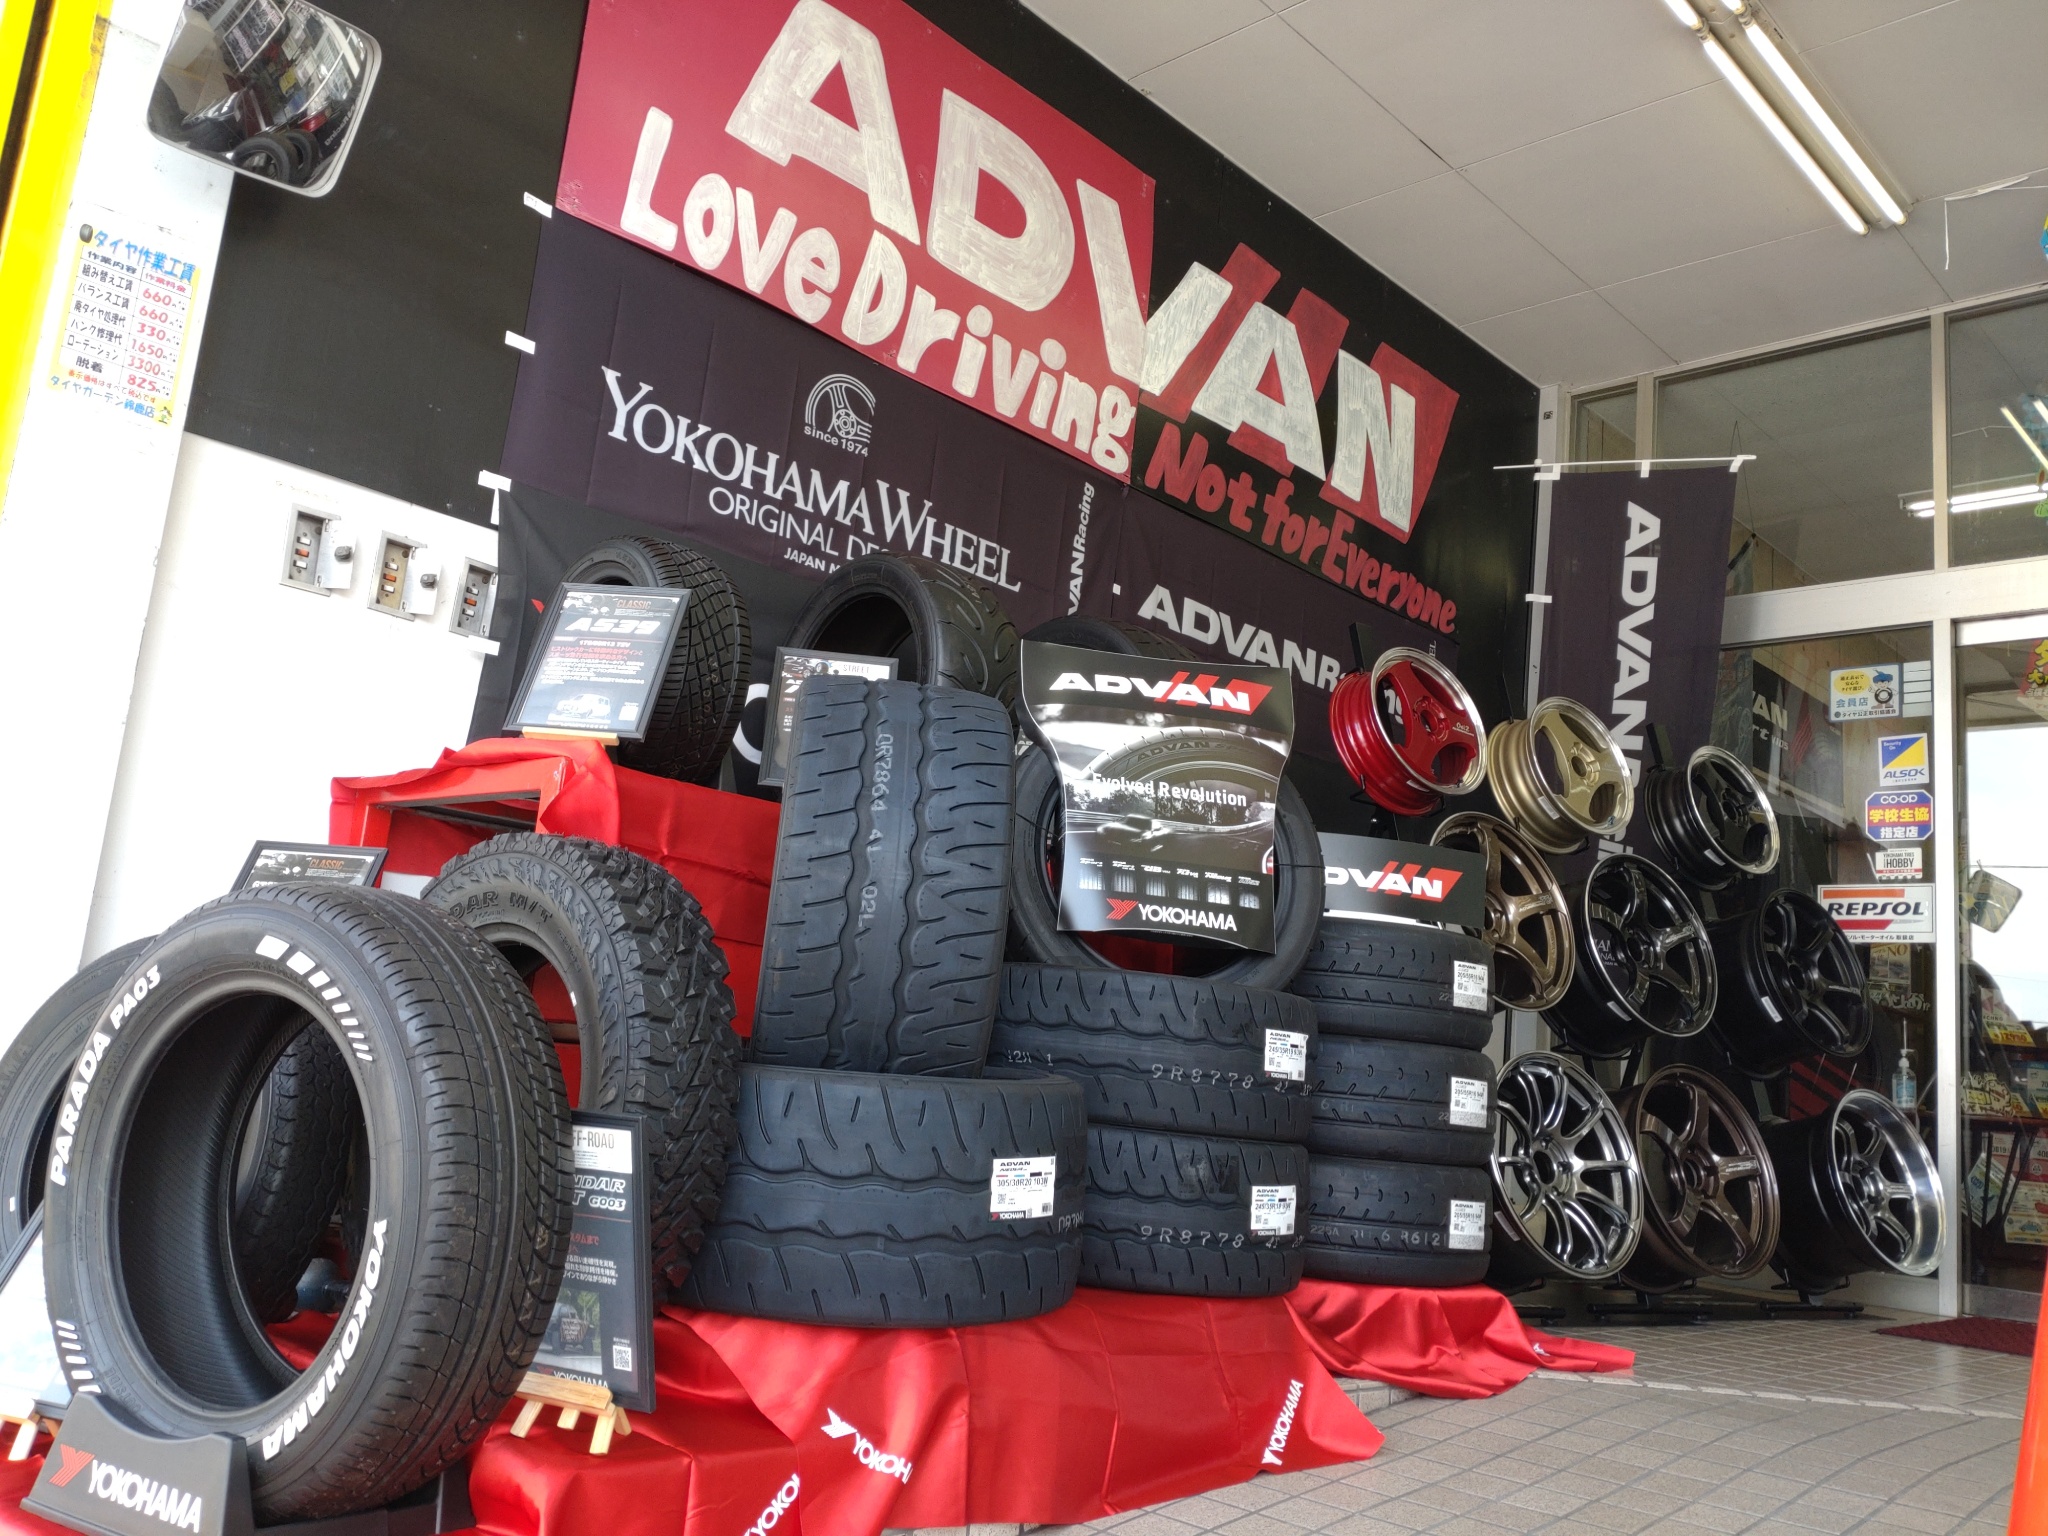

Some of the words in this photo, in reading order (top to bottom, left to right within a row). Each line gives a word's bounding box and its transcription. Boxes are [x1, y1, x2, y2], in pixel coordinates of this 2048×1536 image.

[94, 230, 196, 282] タイヤ作業工賃
[725, 0, 1415, 533] ADVAN
[803, 424, 839, 447] since
[840, 438, 869, 458] 1974
[708, 486, 839, 556] ORIGINAL
[1144, 422, 1259, 533] Not
[1321, 511, 1457, 634] Everyone
[784, 547, 826, 572] JAPAN
[617, 599, 651, 609] CLASSIC
[1049, 672, 1251, 711] ADVAN
[1836, 697, 1869, 708] 会員店
[1883, 767, 1925, 779] ALSOK
[1092, 772, 1155, 797] Evolved
[1159, 780, 1247, 807] Revolution
[1869, 806, 1929, 823] 学校生協
[1880, 826, 1919, 839] 指定店
[309, 859, 345, 870] CLASSIC
[1886, 858, 1915, 868] HOBBY
[1138, 903, 1238, 932] YOKOHAMA
[1827, 901, 1924, 916] REPSOL
[50, 1031, 111, 1187] PARADA
[110, 964, 161, 1030] PA03
[589, 1195, 627, 1213] G003
[262, 1219, 389, 1462] YOKOHAMA
[1268, 1379, 1305, 1453] YOKOHAMA
[88, 1459, 202, 1534] YOKOHAMA
